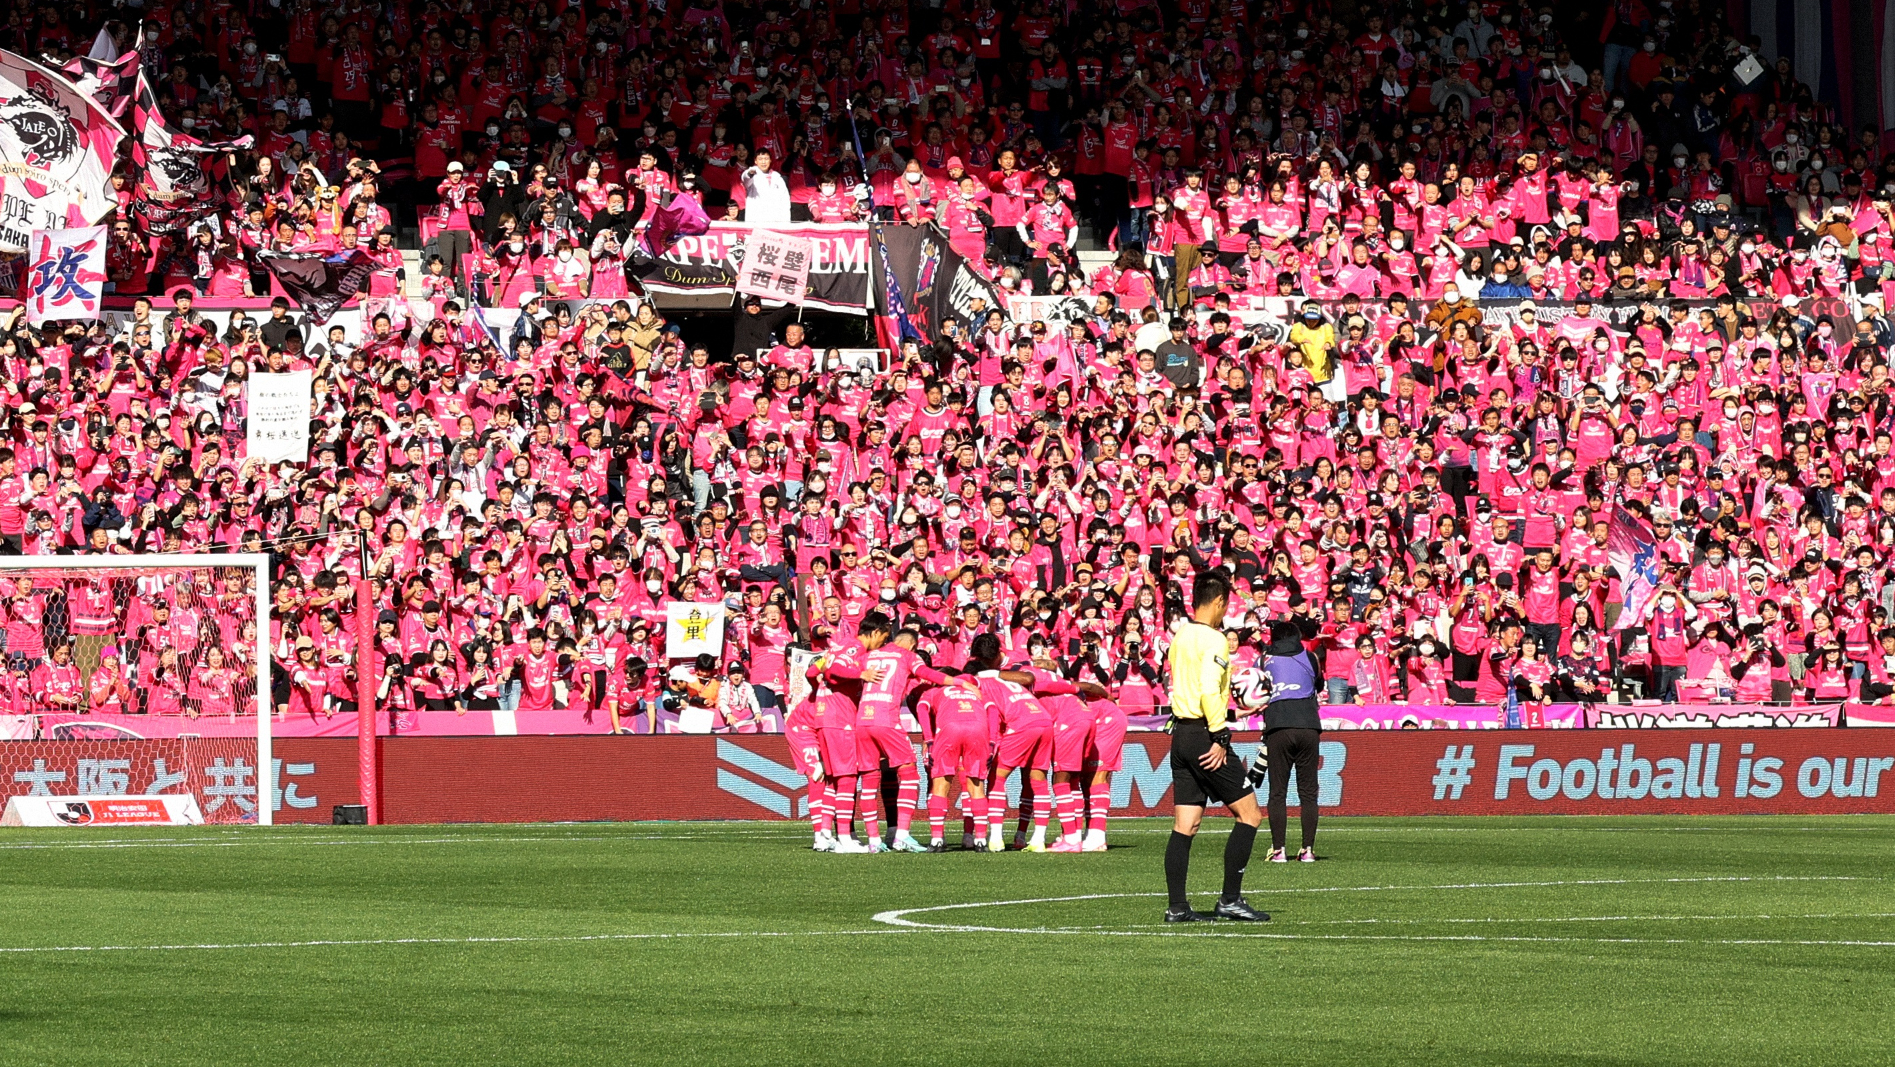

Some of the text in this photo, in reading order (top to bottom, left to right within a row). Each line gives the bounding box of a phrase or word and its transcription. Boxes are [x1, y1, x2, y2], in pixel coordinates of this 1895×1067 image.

[21, 117, 58, 138] JALEO
[1432, 742, 1893, 801] # Football is our
